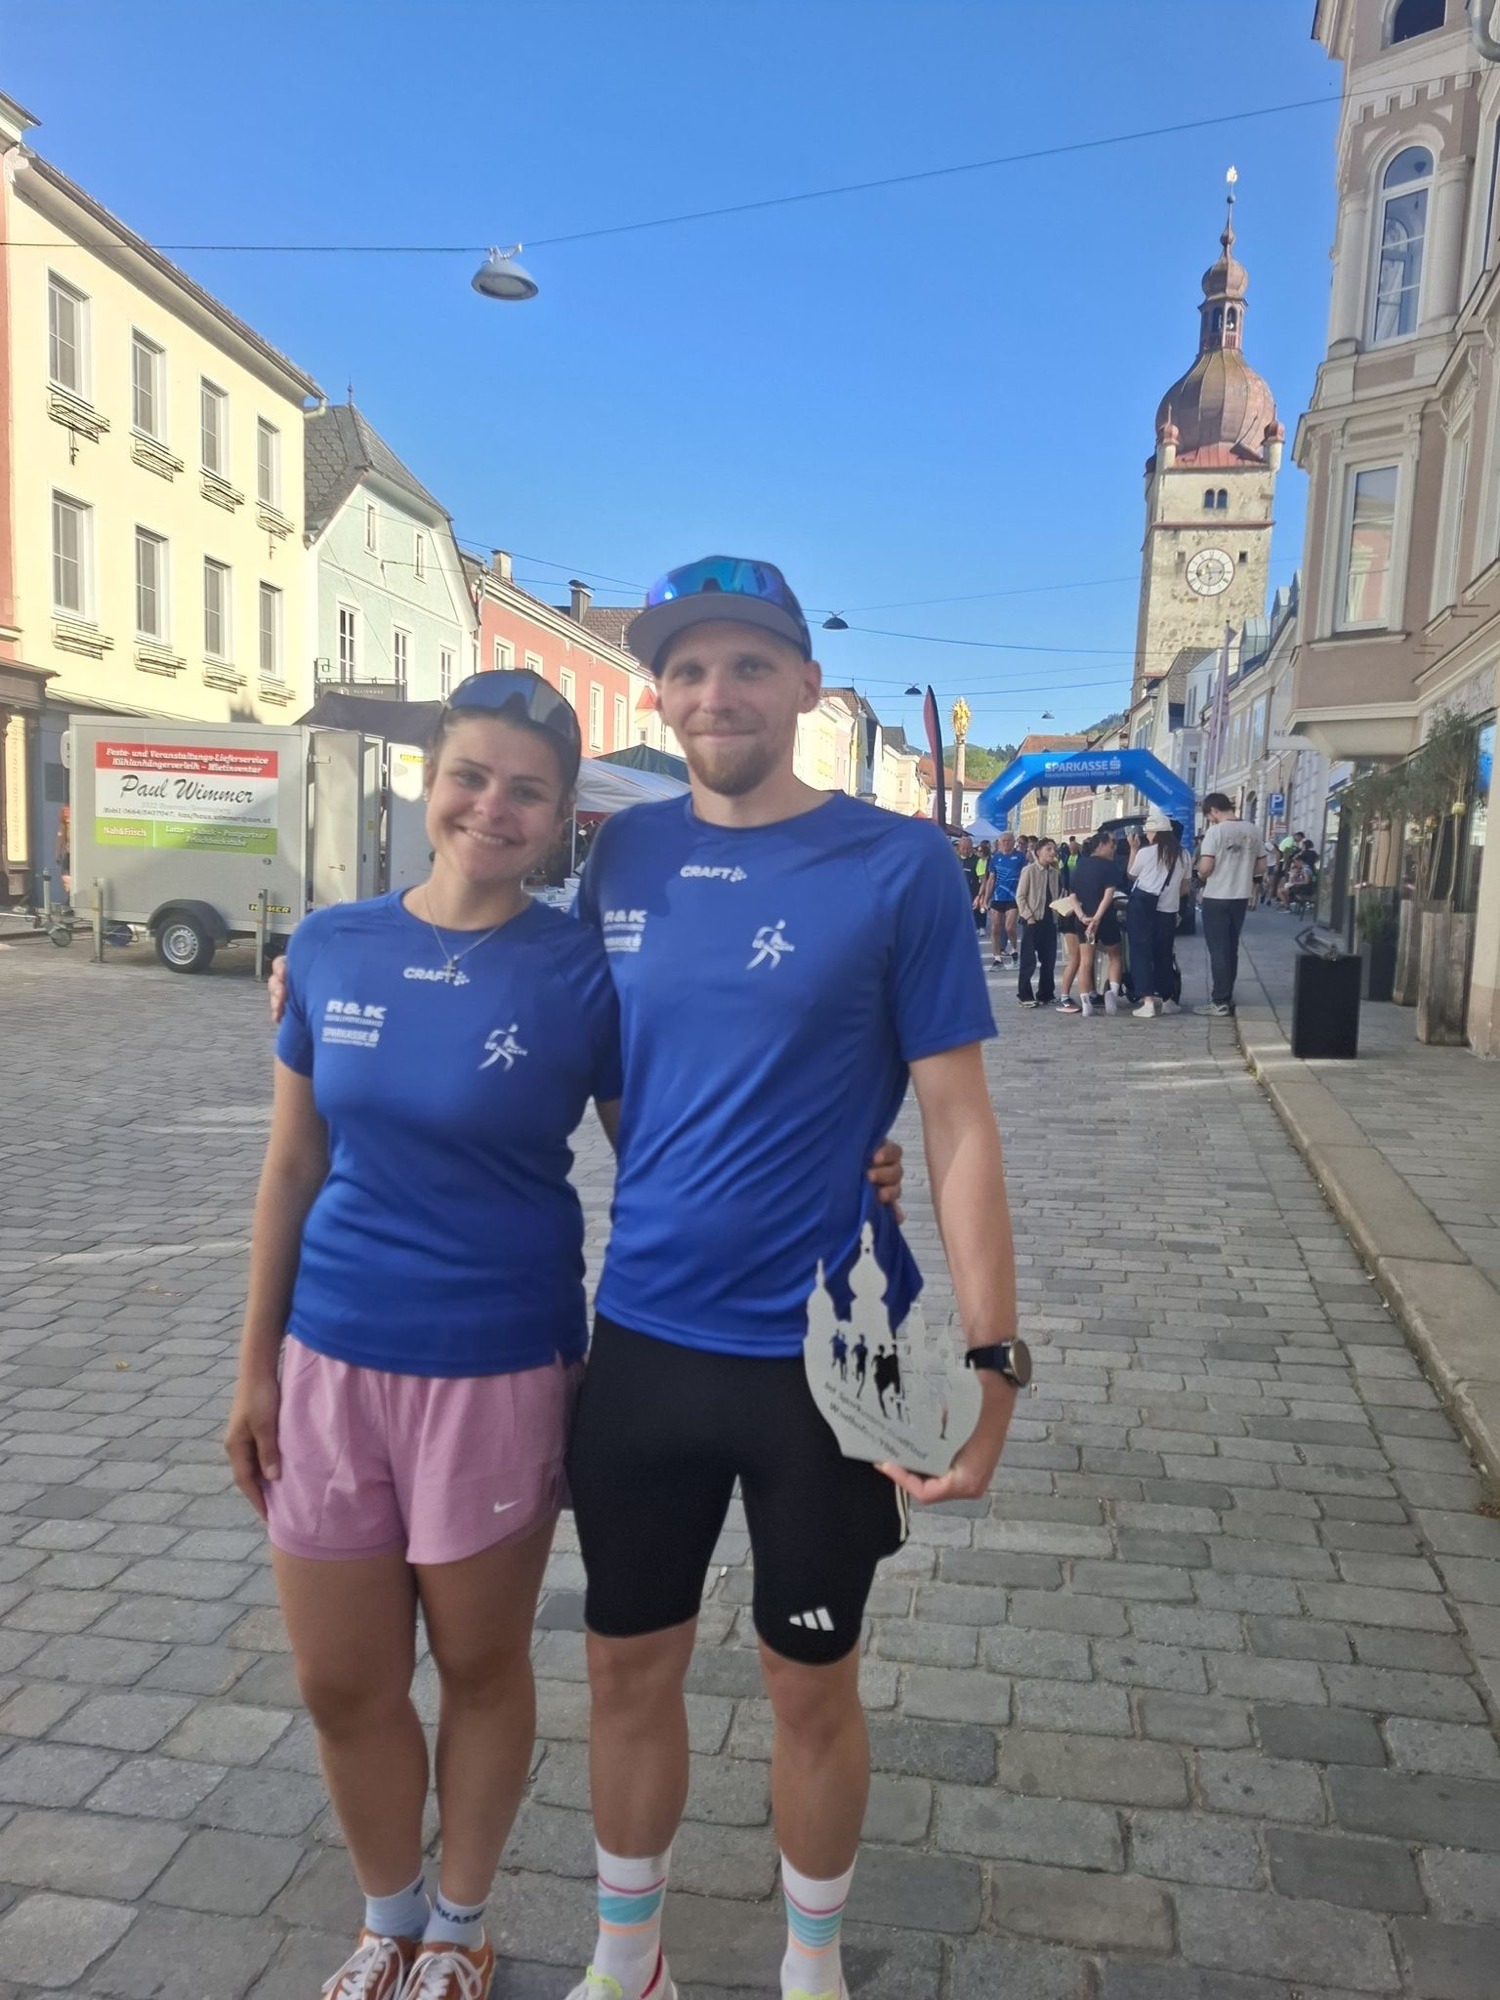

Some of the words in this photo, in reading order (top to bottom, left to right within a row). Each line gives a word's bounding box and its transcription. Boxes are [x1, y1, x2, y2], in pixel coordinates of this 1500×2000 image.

[131, 749, 148, 758] und
[208, 762, 263, 774] Mietinventar
[1045, 760, 1109, 772] SPARKASSE
[119, 774, 169, 798] Paul
[173, 778, 255, 804] Wimmer
[1271, 794, 1283, 809] P
[103, 826, 147, 837] Nah&Frisch
[680, 865, 732, 880] CRAFT
[250, 904, 290, 914] HMER
[402, 967, 454, 984] CRAFT
